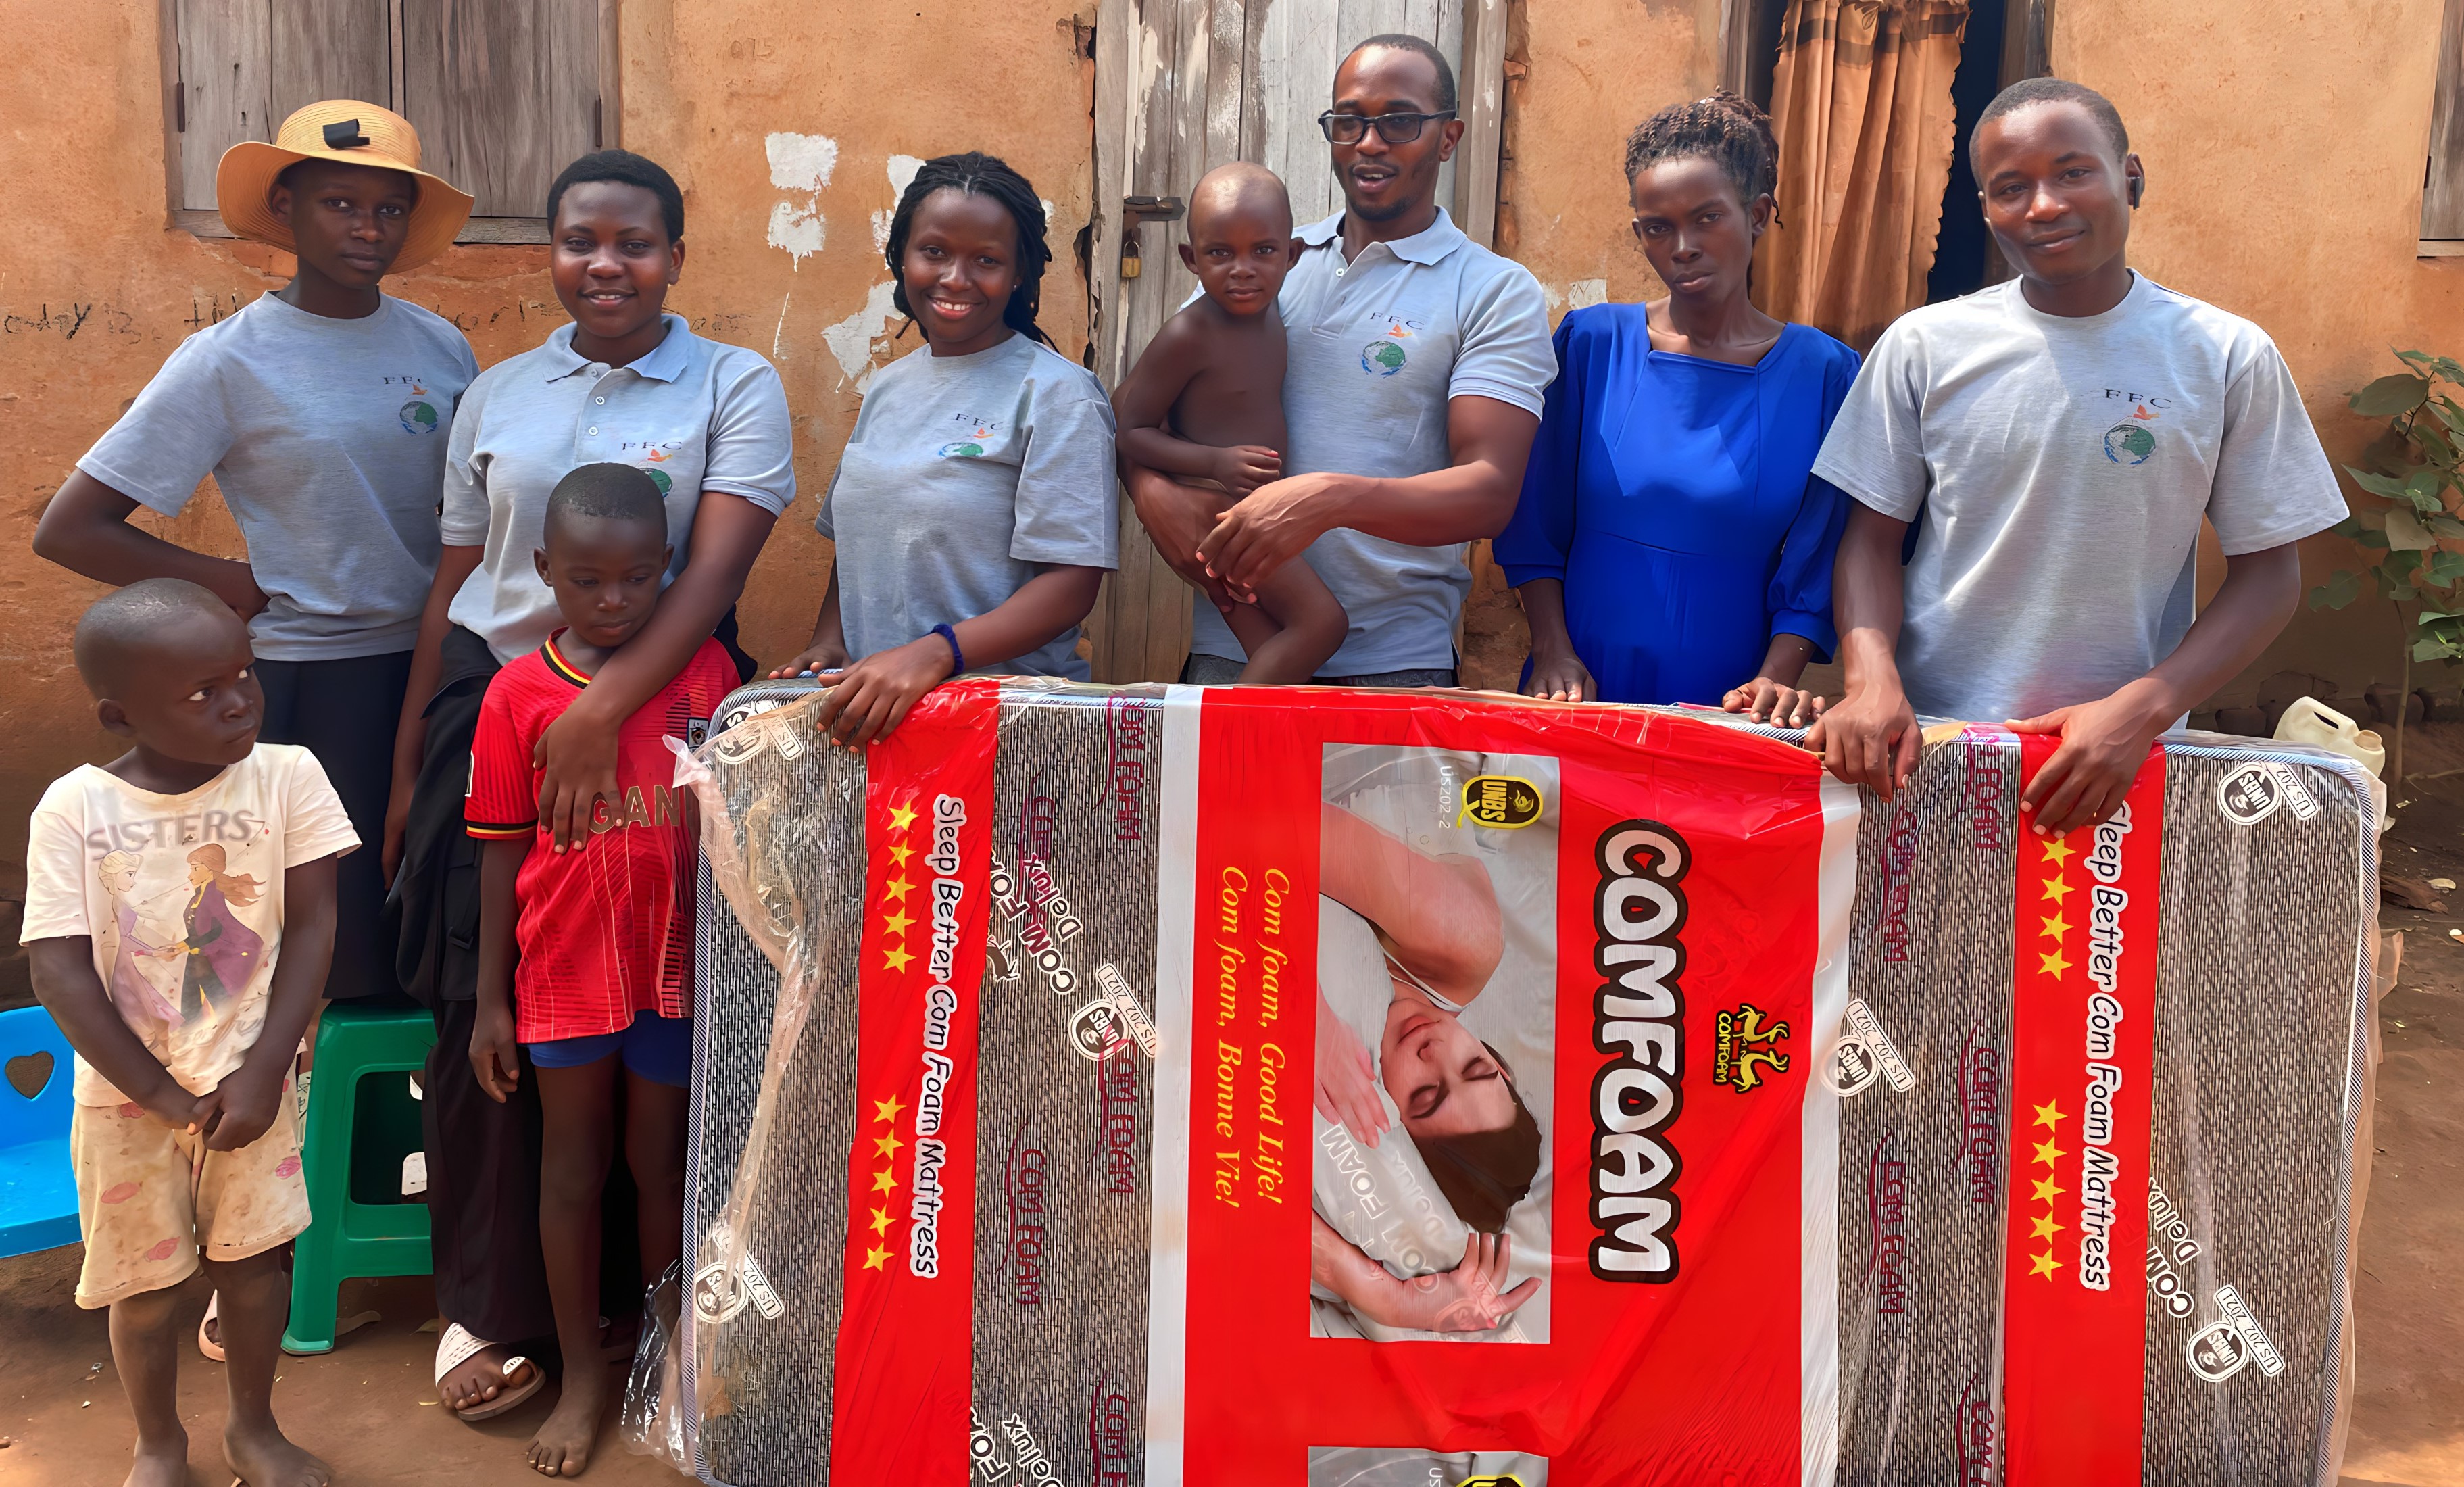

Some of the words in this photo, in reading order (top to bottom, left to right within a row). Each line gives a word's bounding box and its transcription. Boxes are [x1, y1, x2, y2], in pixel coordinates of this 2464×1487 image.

[1370, 312, 1425, 330] FFC
[2103, 389, 2171, 409] FFC
[621, 441, 683, 451] FFC
[1479, 781, 1507, 821] UNBS
[2238, 773, 2271, 810] UNBS
[2293, 791, 2311, 812] US
[87, 810, 257, 860] SISTERS
[931, 799, 964, 872] Sleep
[1022, 853, 1082, 941] Delux
[1222, 867, 1248, 933] Com
[1264, 868, 1290, 935] Com
[931, 883, 962, 979] Better
[1019, 923, 1076, 994] COM
[2093, 889, 2123, 986] Better
[1104, 973, 1128, 1000] 2021
[1215, 941, 1246, 1027] foam,
[1257, 942, 1288, 1027] foam,
[929, 990, 955, 1046] Com
[1089, 1008, 1120, 1046] UNBS
[1141, 1029, 1156, 1049] US
[1715, 1013, 1731, 1083] COMFOAM
[1853, 1008, 1877, 1036] 2021
[2090, 996, 2118, 1054] Com
[1259, 1042, 1285, 1126] Good
[1590, 820, 1691, 1283] COMFOAM
[1838, 1044, 1869, 1083] UNBS
[1890, 1064, 1907, 1084] US
[922, 1056, 950, 1131] Foam
[1216, 1039, 1242, 1138] Bonne
[2088, 1065, 2117, 1140] Foam
[1018, 1148, 1046, 1213] COM
[1215, 1149, 1240, 1208] Vie!
[1251, 1131, 1283, 1204] Life!
[915, 1142, 943, 1275] Mattress
[2085, 1150, 2115, 1286] Mattress
[1016, 1225, 1043, 1305] FOAM
[2146, 1246, 2194, 1318] COM
[759, 1291, 777, 1311] US
[2223, 1293, 2247, 1322] 2021
[2207, 1330, 2239, 1367] UNBS
[2260, 1348, 2277, 1369] US
[1104, 1394, 1129, 1459] COM
